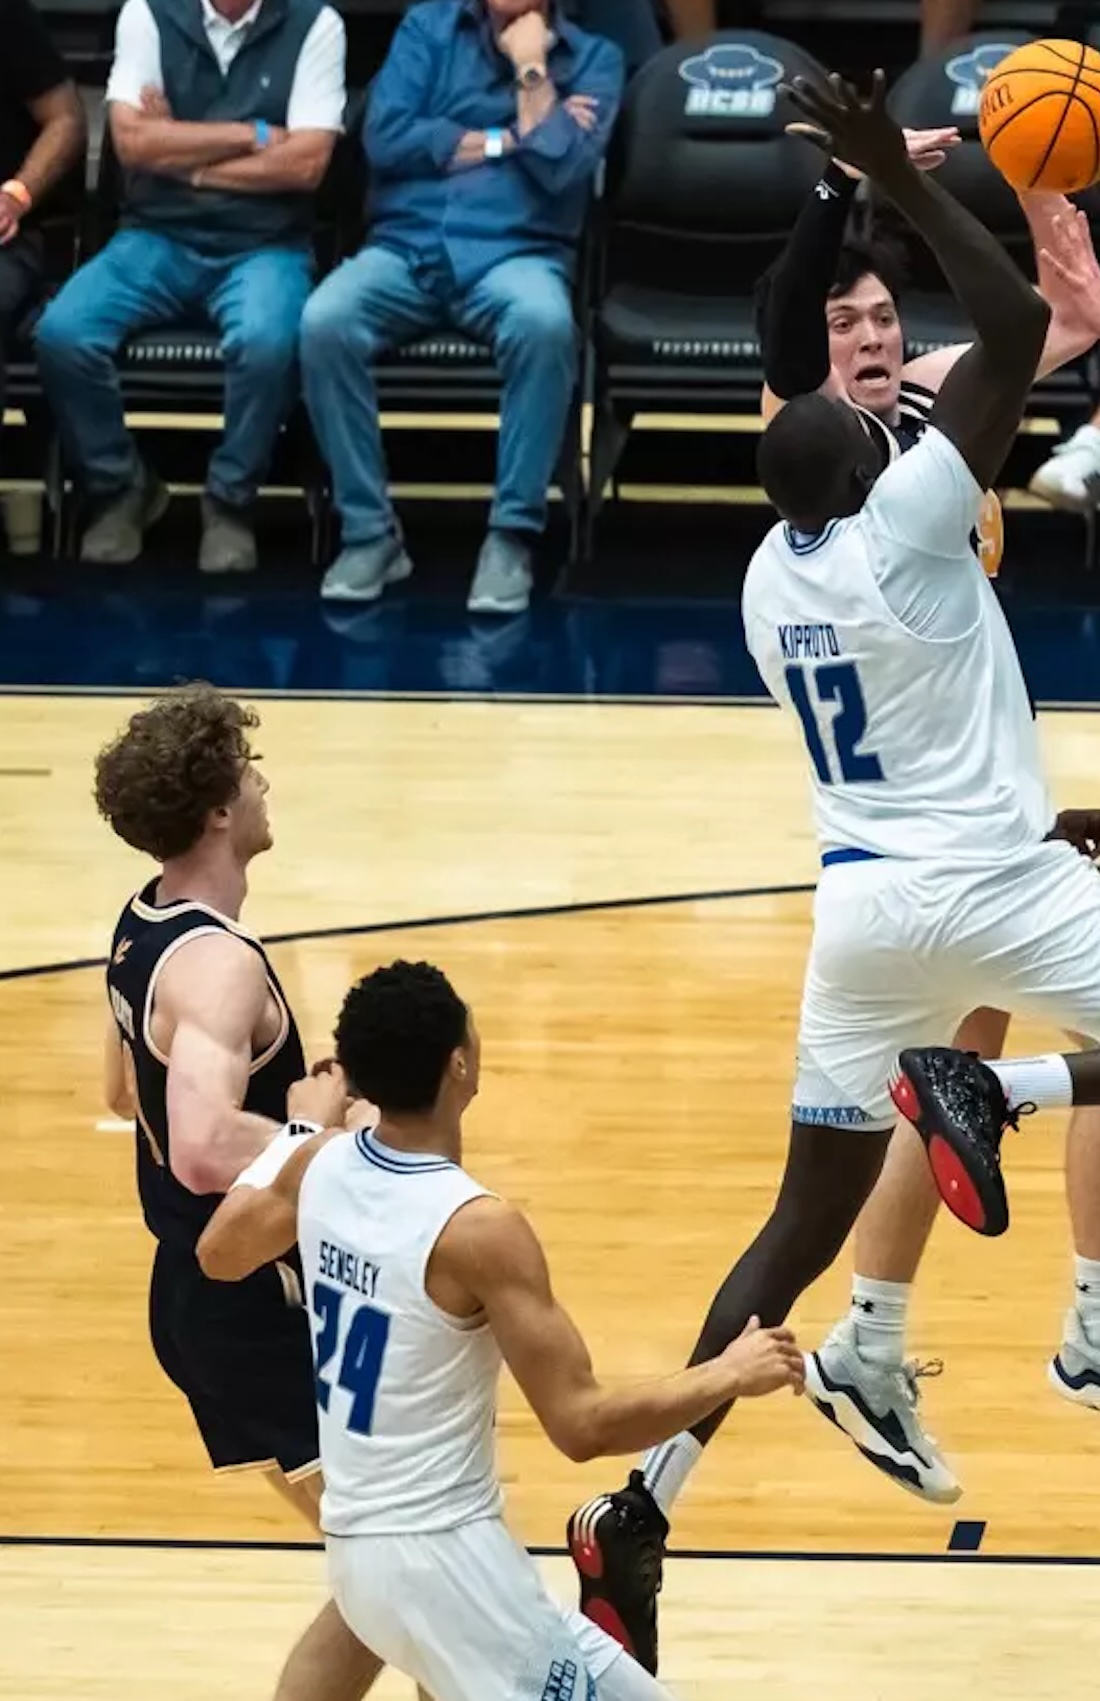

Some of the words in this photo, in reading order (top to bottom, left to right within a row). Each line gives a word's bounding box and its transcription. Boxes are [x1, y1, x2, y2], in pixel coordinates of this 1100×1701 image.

[784, 660, 888, 785] 12
[318, 1240, 380, 1299] SENSLEY
[312, 1279, 393, 1437] 24
